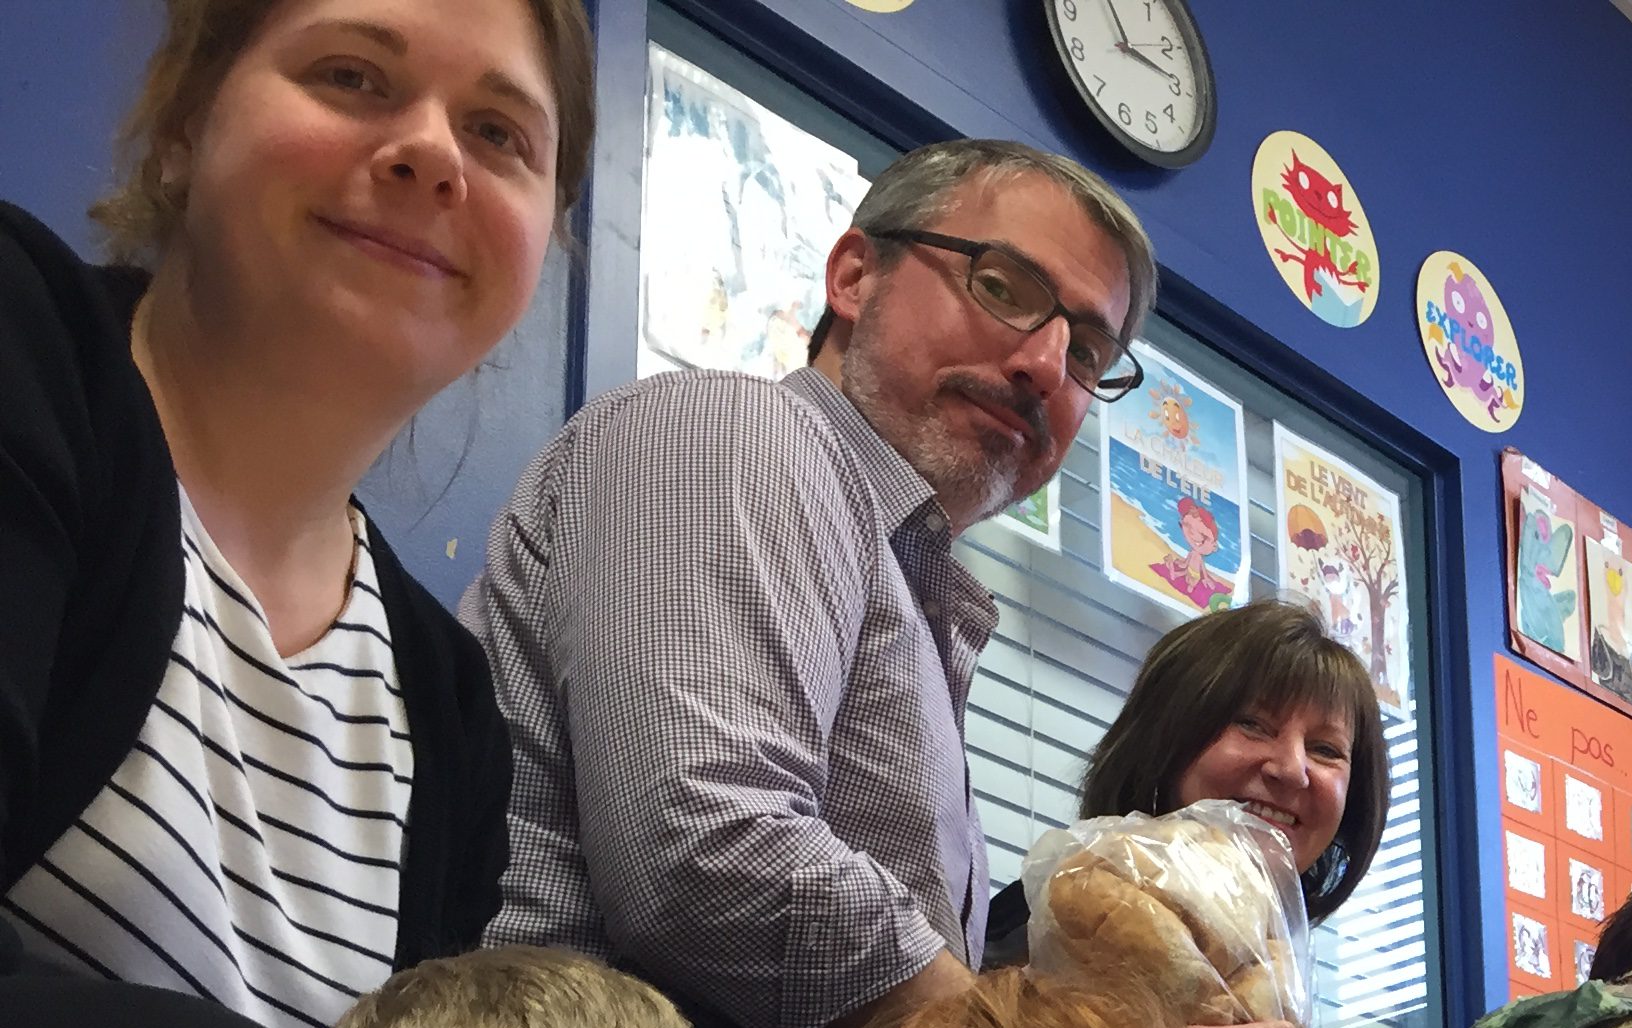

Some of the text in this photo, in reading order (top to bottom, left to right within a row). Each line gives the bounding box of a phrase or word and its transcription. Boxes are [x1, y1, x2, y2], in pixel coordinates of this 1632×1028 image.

[1063, 0, 1077, 21] 9
[1143, 2, 1151, 21] 1
[1070, 37, 1085, 61] 8
[1161, 36, 1174, 60] 2
[1093, 74, 1106, 96] 7
[1168, 74, 1181, 96] 3
[1118, 102, 1132, 126] 6
[1145, 111, 1158, 135] 5
[1163, 104, 1175, 123] 4
[1262, 187, 1372, 285] POINTER
[1425, 300, 1518, 391] EXPLORER
[1124, 421, 1144, 448] LA
[1140, 453, 1163, 481] DE
[1285, 469, 1309, 498] DE
[1310, 460, 1368, 510] LE VENT
[1504, 669, 1540, 739] Ne
